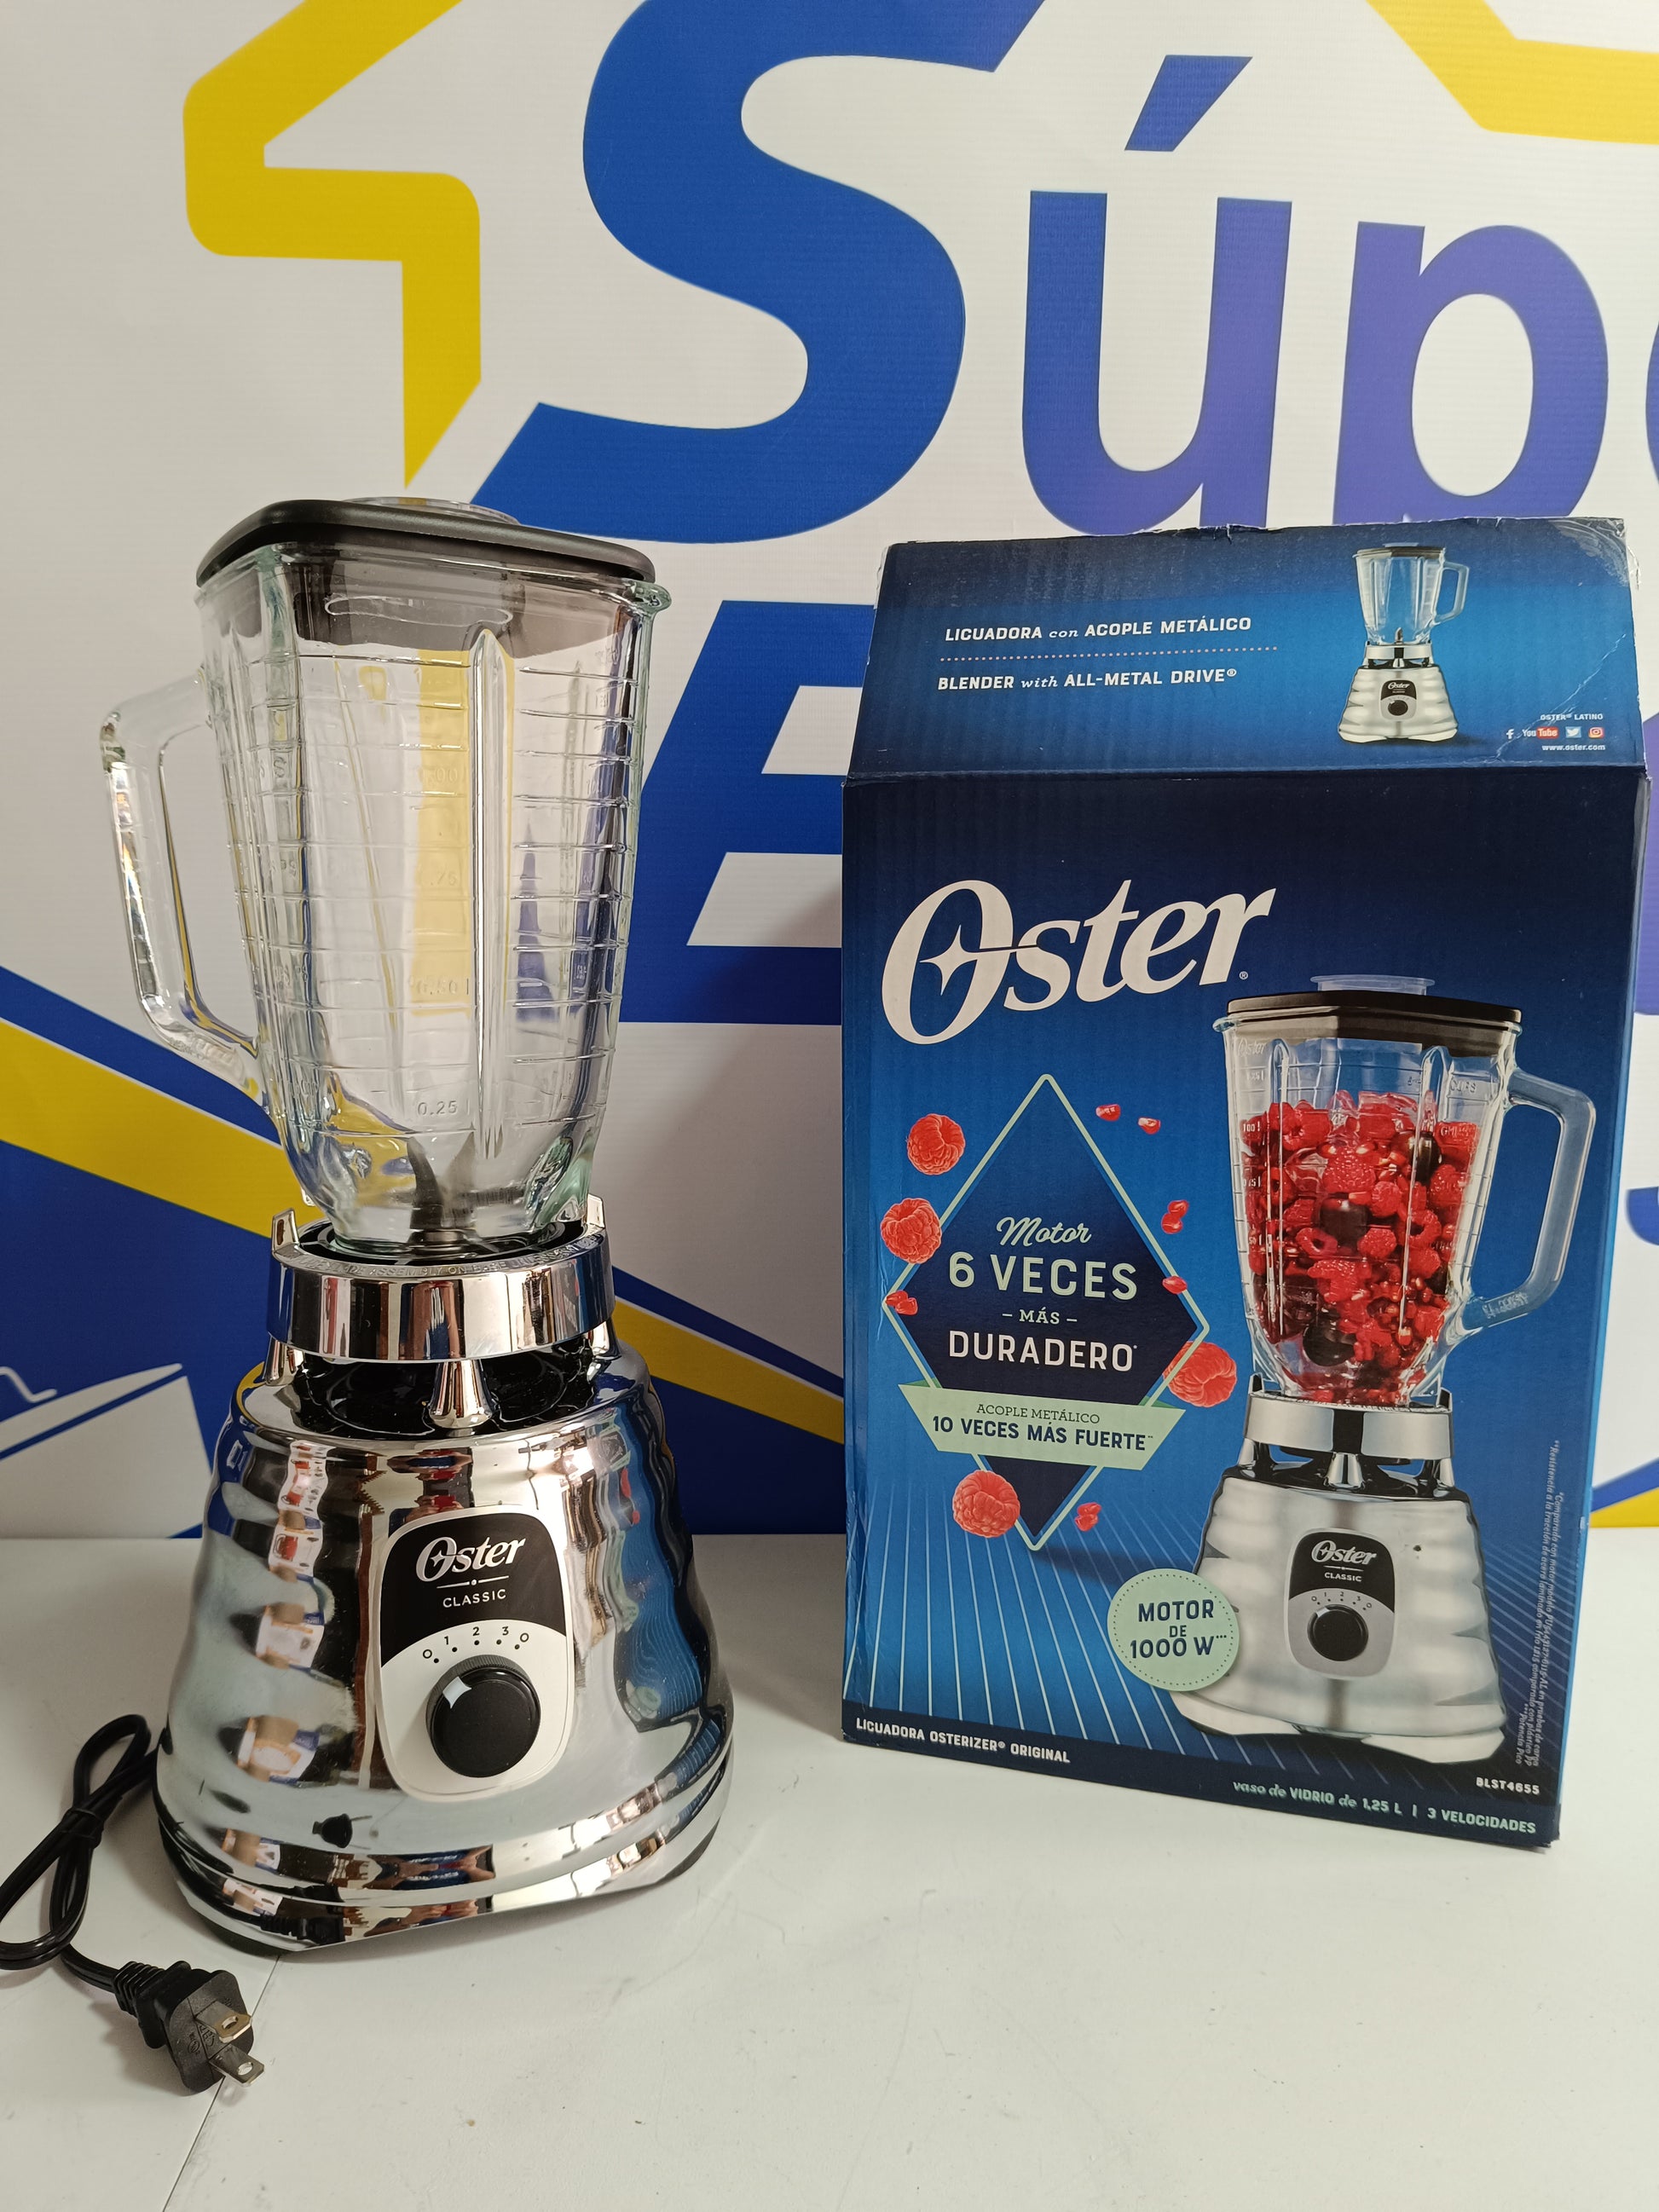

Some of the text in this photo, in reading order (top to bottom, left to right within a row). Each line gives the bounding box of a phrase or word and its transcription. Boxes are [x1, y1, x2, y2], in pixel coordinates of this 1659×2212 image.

[475, 0, 1659, 544] Súp
[945, 615, 1251, 641] LICUADORA con ACOPLE METÁLICO
[938, 676, 1014, 690] BLENDER
[1021, 676, 1058, 689] with
[1064, 672, 1163, 687] ALL-METAL
[997, 1216, 1092, 1246] Motor
[949, 1251, 1137, 1301] 6 VECES
[1019, 1306, 1061, 1325] MÁS
[976, 1403, 1101, 1424] ACOPLE METÁLICO
[933, 1415, 953, 1433] 10
[961, 1418, 1020, 1440] VECES
[1027, 1421, 1067, 1444] MÁS
[416, 1536, 526, 1582] Oster
[1311, 1539, 1378, 1565] Oster
[1324, 1572, 1362, 1582] CLASSIC
[442, 1589, 506, 1608] CLASSIC
[1138, 1599, 1214, 1622] MOTOR
[443, 1635, 450, 1646] 1
[472, 1626, 480, 1637] 2
[501, 1626, 510, 1637] 3
[1169, 1625, 1187, 1637] DE
[1130, 1637, 1188, 1659] 1000
[856, 1718, 924, 1741] LICUADORA
[1010, 1743, 1071, 1764] ORIGINAL
[1476, 1776, 1540, 1795] BLST4655
[1233, 1781, 1266, 1795] vaso
[1269, 1783, 1287, 1798] de
[1289, 1787, 1335, 1805] VIDRIO
[1338, 1793, 1357, 1808] de
[1394, 1801, 1403, 1816] L
[1427, 1807, 1436, 1821] 3
[1441, 1809, 1536, 1834] VELOCIDADES
